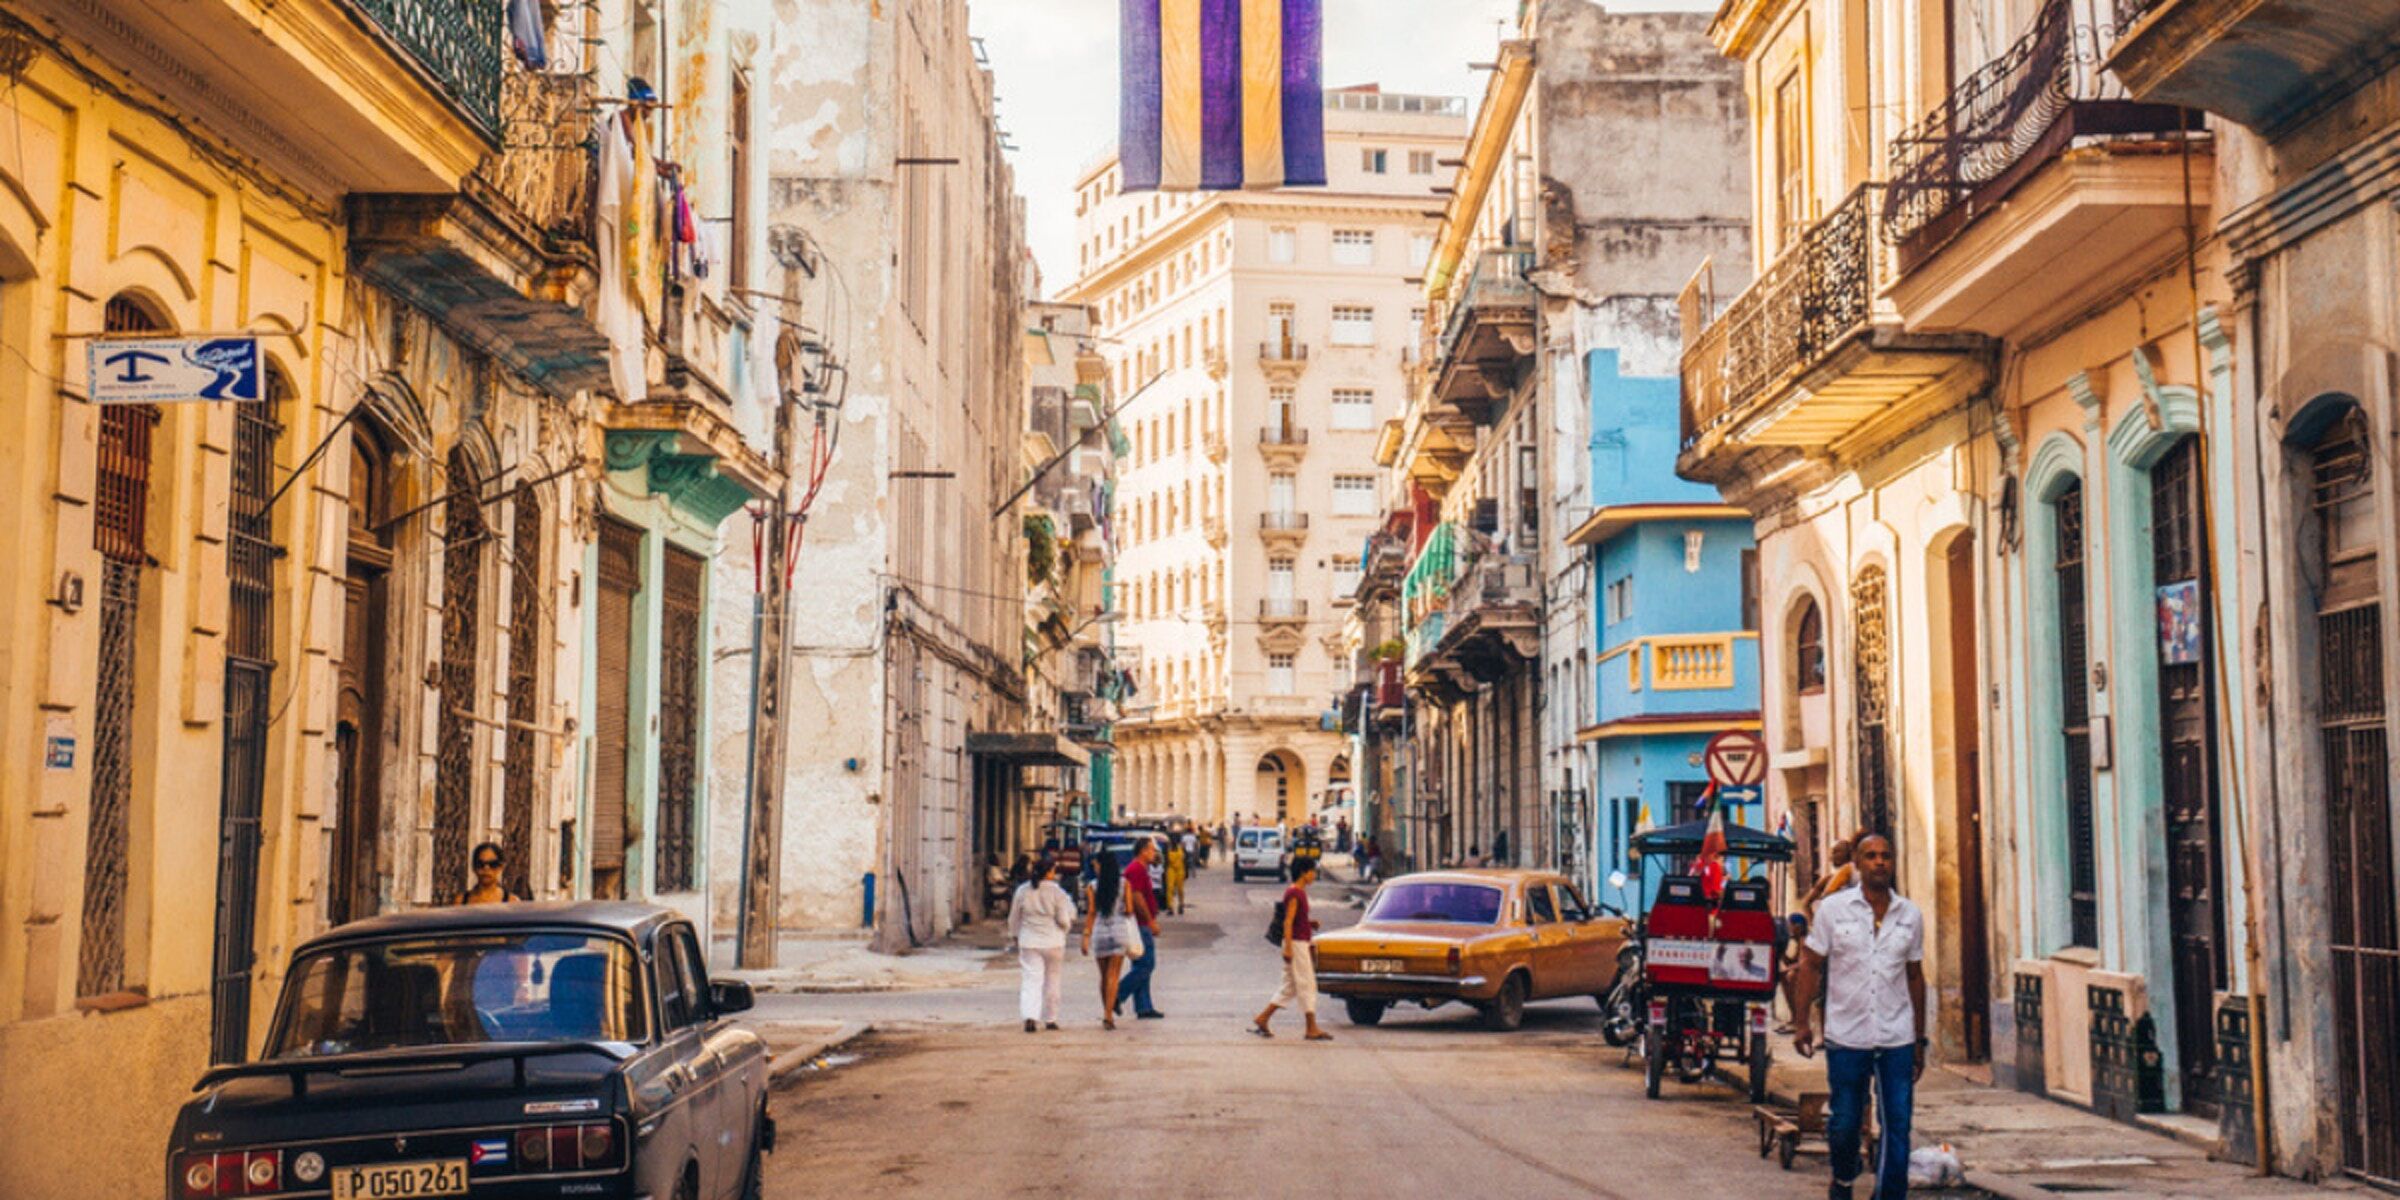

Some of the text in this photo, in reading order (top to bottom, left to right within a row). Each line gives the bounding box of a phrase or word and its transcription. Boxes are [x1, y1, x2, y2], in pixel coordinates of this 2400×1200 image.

[350, 1172, 365, 1198] P
[370, 1169, 415, 1197] 050
[419, 1164, 464, 1193] 261
